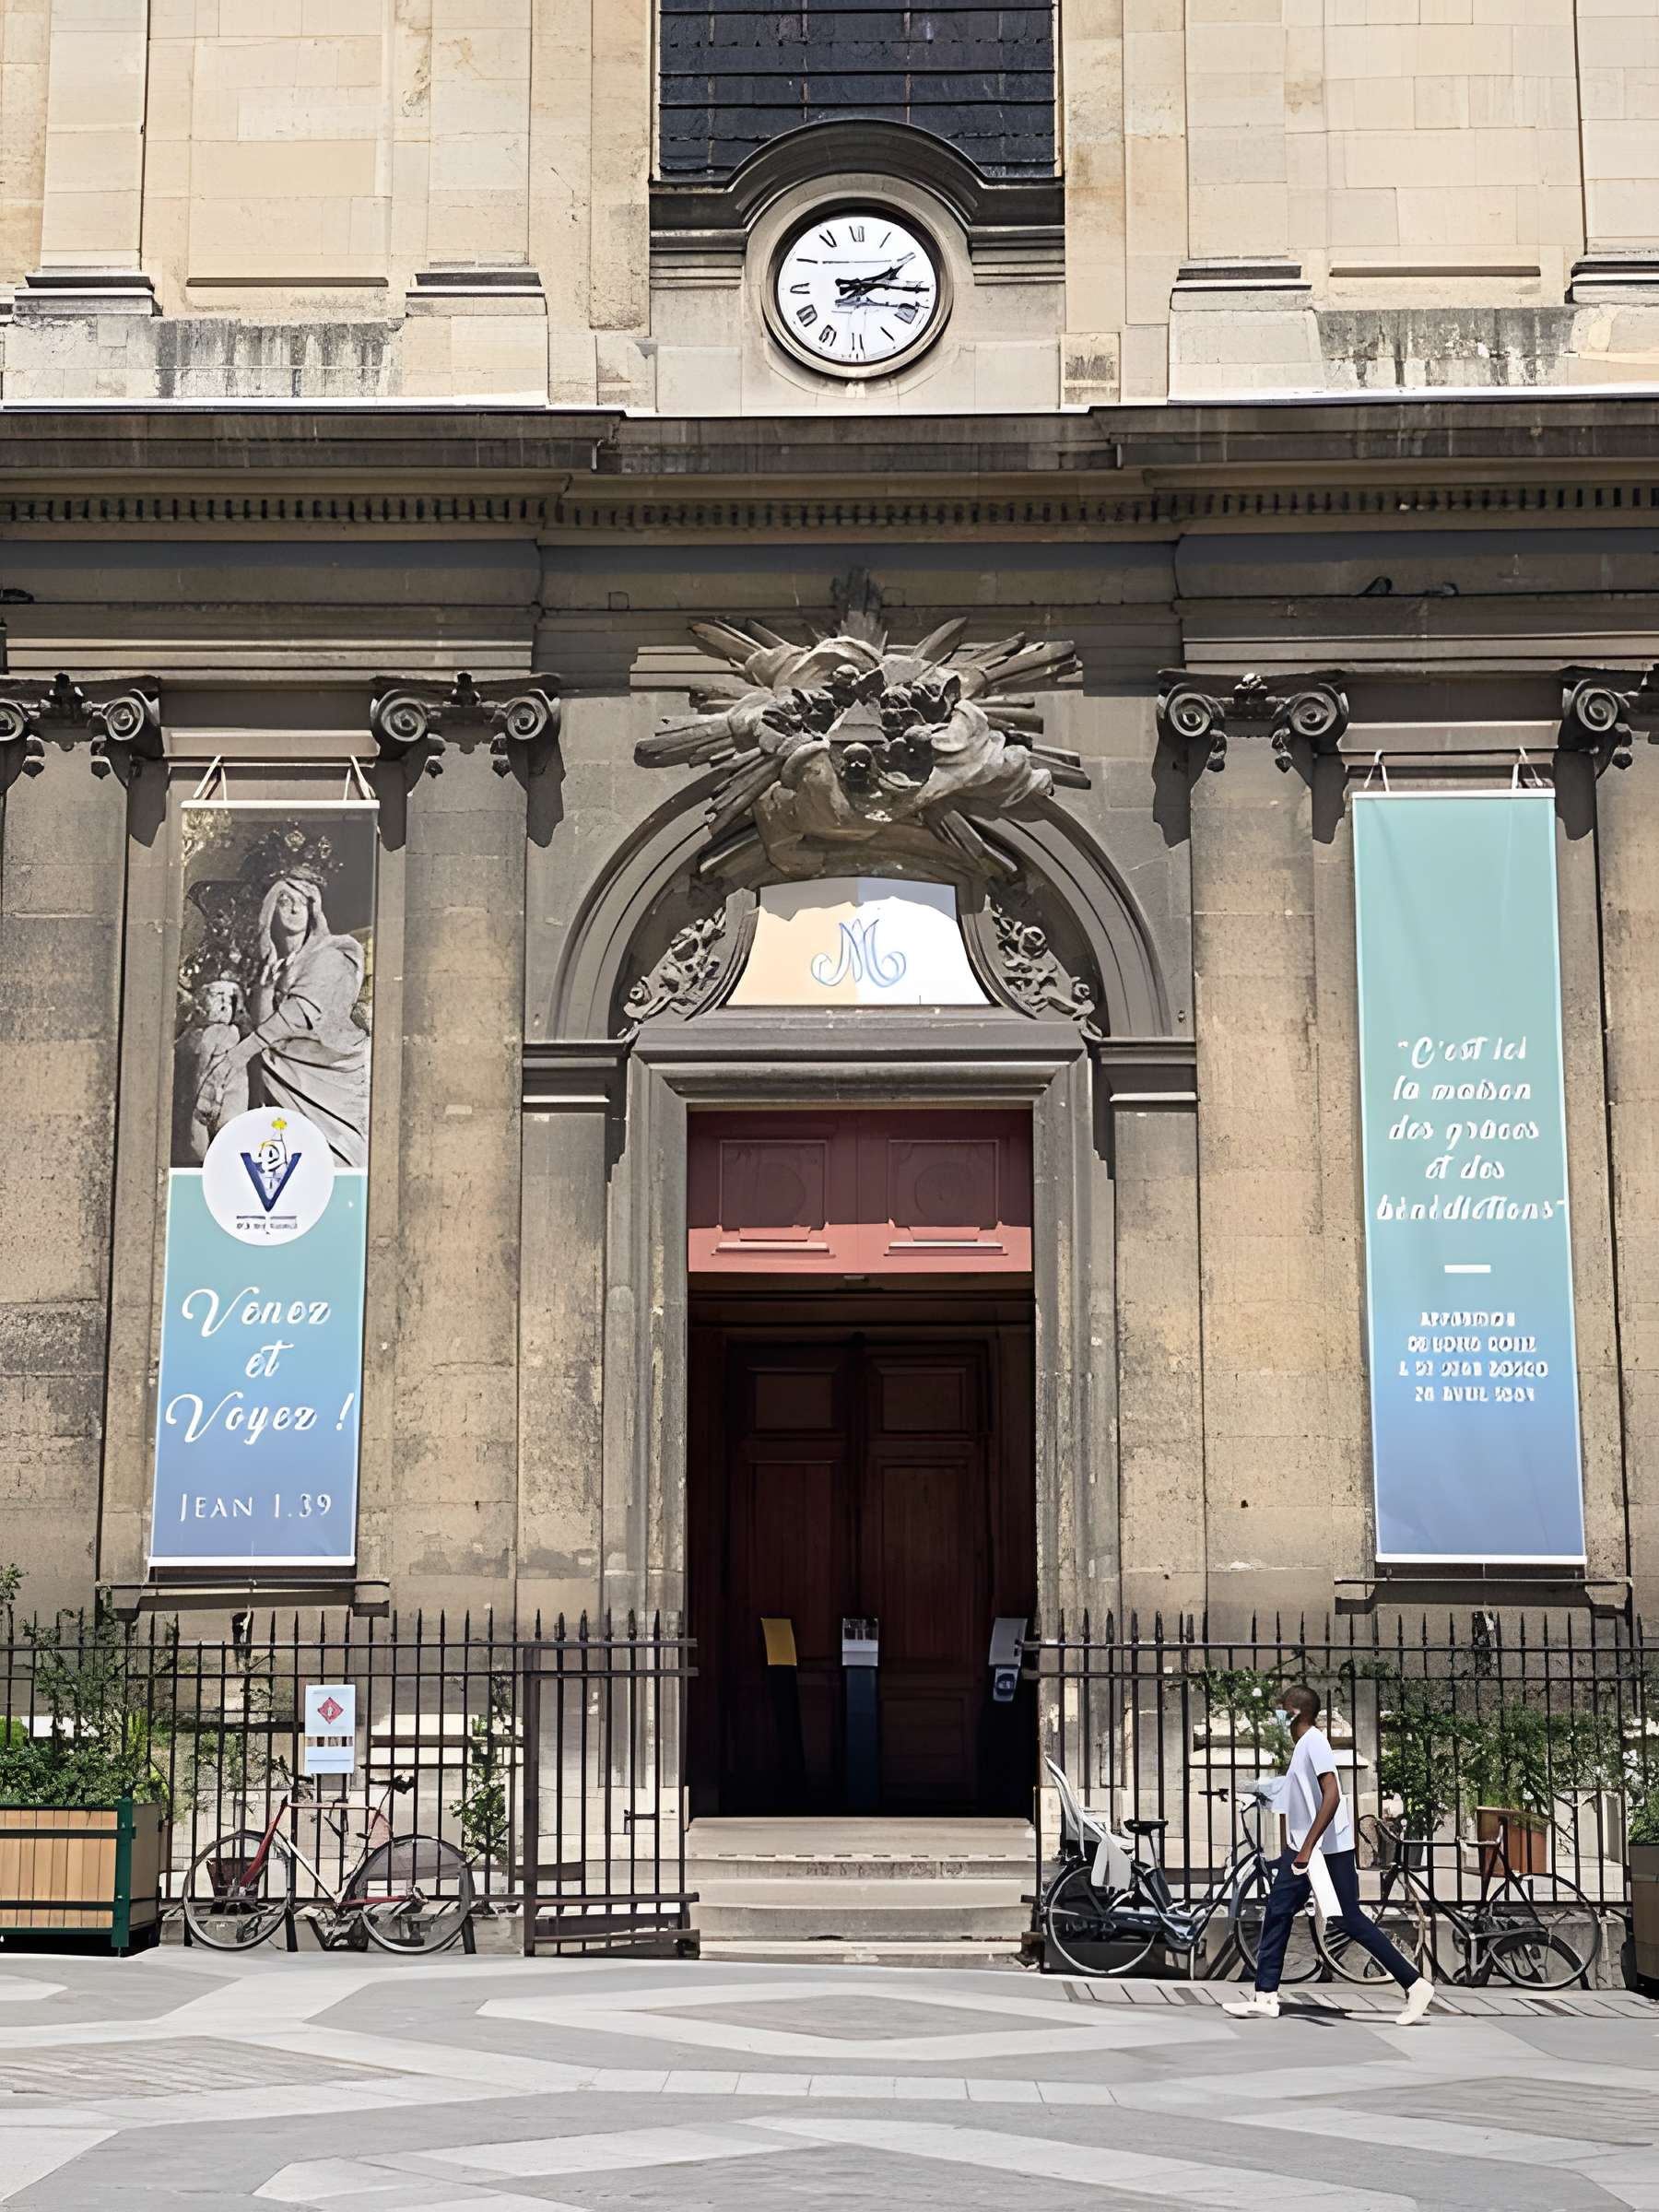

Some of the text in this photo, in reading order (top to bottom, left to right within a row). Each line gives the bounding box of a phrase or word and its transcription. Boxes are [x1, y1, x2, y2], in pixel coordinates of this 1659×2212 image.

[1393, 1076, 1420, 1100] la
[182, 1287, 332, 1337] Venez
[245, 1339, 295, 1378] et
[165, 1391, 318, 1445] Voyez
[180, 1493, 253, 1522] JEAN
